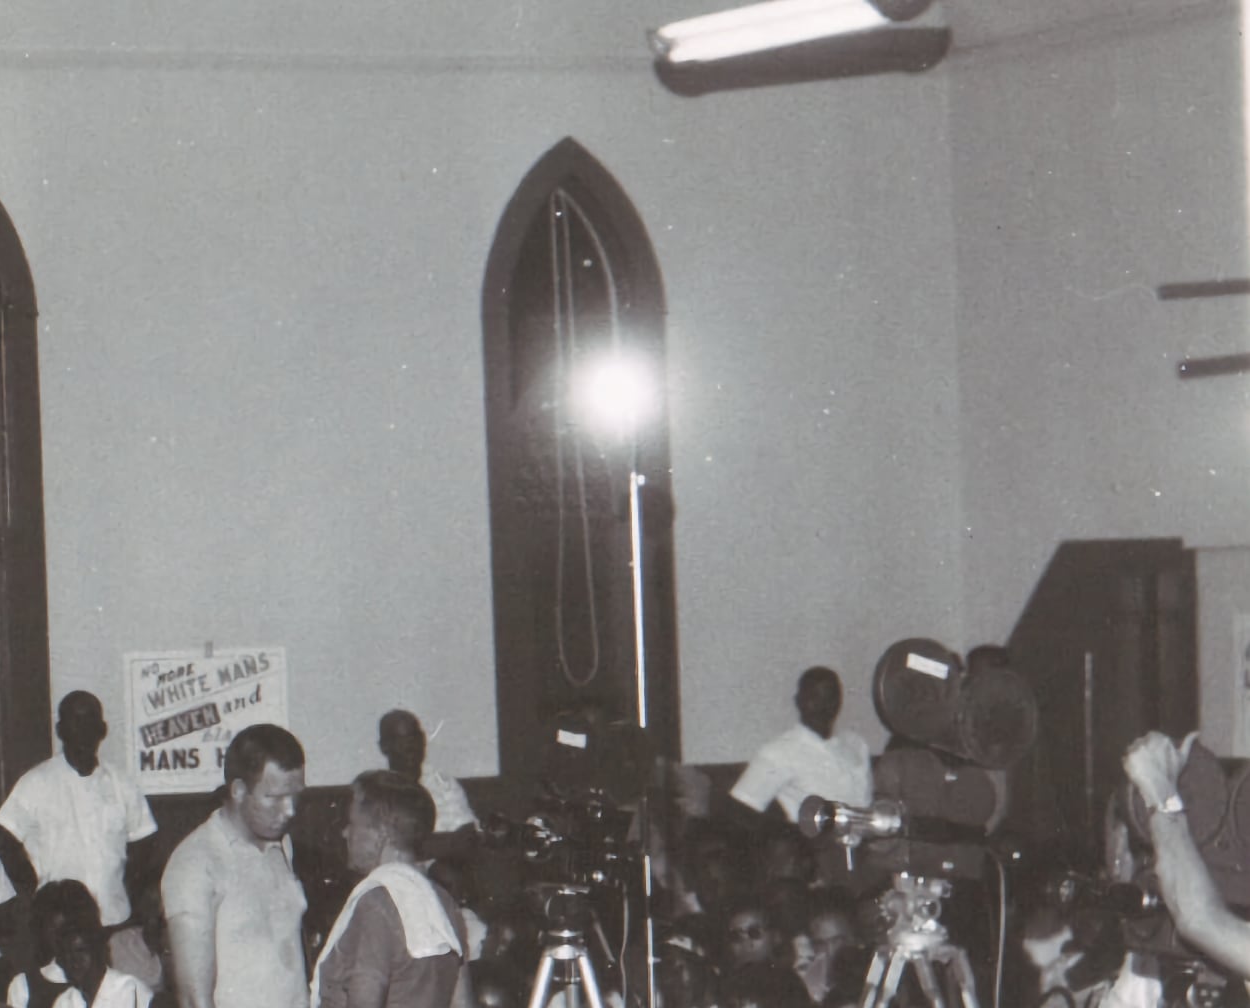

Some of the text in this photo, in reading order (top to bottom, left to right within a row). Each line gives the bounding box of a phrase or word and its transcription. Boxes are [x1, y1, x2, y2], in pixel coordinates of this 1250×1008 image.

[147, 652, 271, 710] WHITE MANS
[141, 704, 220, 746] HEAVEN
[140, 748, 200, 772] MANS
